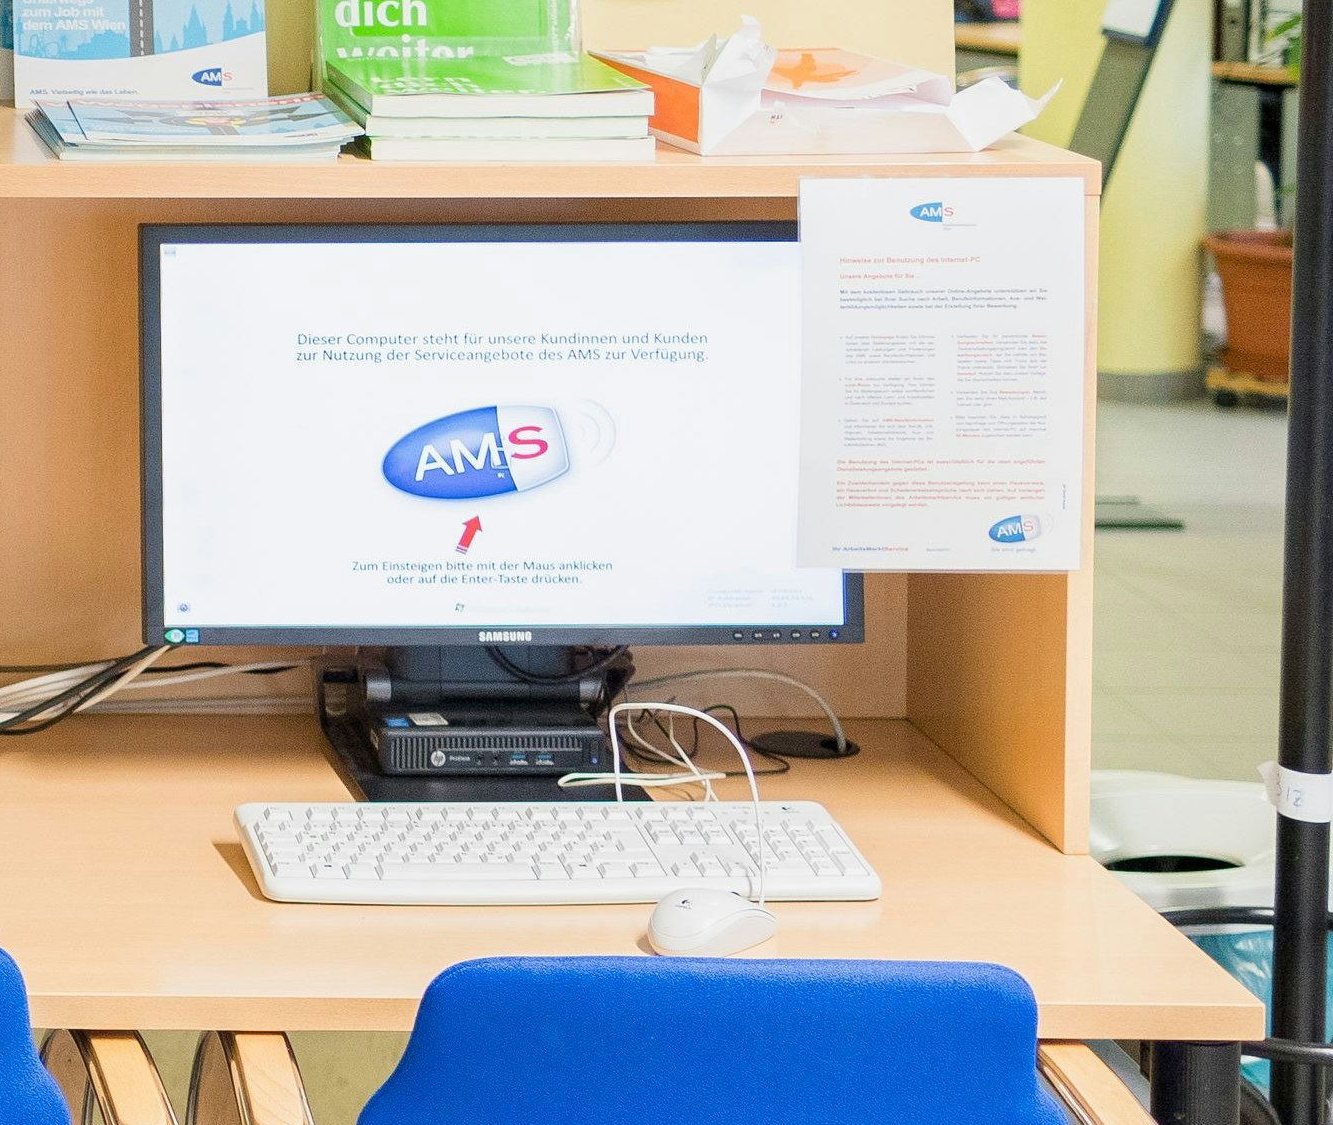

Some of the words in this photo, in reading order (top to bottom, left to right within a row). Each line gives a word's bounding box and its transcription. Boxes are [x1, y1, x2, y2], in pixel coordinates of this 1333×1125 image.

[54, 6, 80, 19] Job
[82, 6, 104, 19] mit
[334, 0, 427, 28] dich
[20, 20, 52, 32] dem
[55, 18, 88, 30] AMS
[91, 19, 128, 32] Wien
[201, 72, 233, 82] AMS
[920, 207, 954, 216] AMS
[298, 333, 341, 344] Dieser
[346, 334, 417, 344] Computer
[423, 334, 457, 344] steht
[464, 332, 481, 344] für
[488, 336, 535, 344] unsere
[541, 333, 616, 343] Kundinnen
[622, 333, 648, 343] und
[654, 333, 707, 343] Kunden
[296, 352, 317, 360] zur
[323, 350, 381, 362] Nutzung
[386, 349, 409, 360] der
[415, 350, 533, 360] Serviceangebote
[538, 349, 562, 359] des
[567, 349, 600, 359] AMS
[631, 348, 709, 361] Verfügung.
[415, 426, 548, 482] AMS
[997, 521, 1033, 537] AMS
[352, 561, 378, 570] Zum
[382, 561, 442, 572] Einsteigen
[446, 562, 472, 570] bitte
[500, 561, 517, 570] der
[523, 561, 554, 570] Maus
[559, 561, 612, 570] anklicken
[387, 575, 412, 583] oder
[418, 574, 435, 583] auf
[440, 574, 457, 583] die
[462, 574, 527, 583] Enter-Taste
[532, 574, 582, 583] drücken.
[479, 632, 532, 642] SAMSUNG
